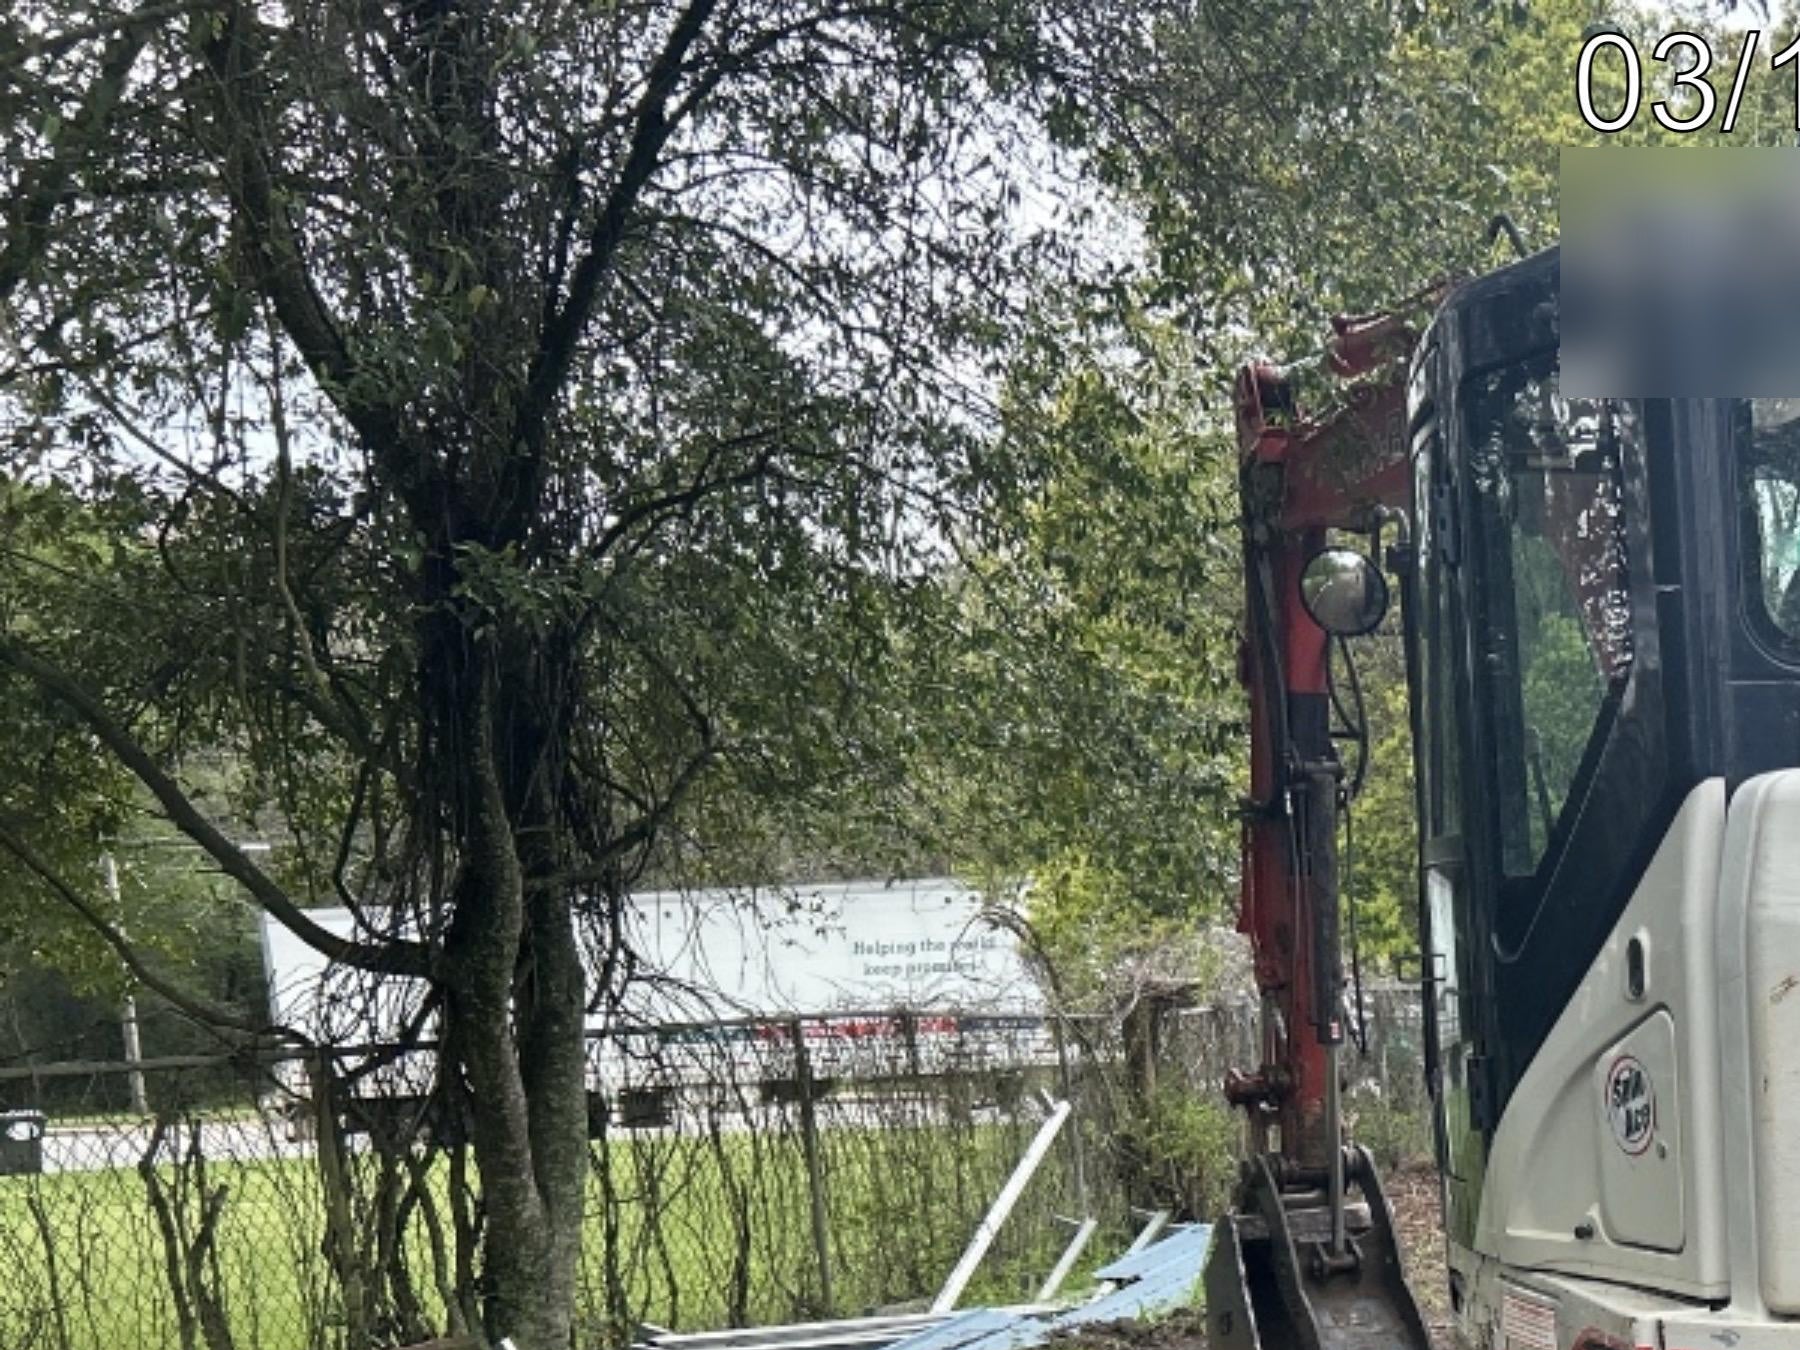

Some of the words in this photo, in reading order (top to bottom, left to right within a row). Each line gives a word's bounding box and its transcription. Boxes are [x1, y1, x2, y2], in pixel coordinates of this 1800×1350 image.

[853, 939, 916, 957] Helping
[920, 938, 946, 952] the
[863, 963, 903, 978] keep
